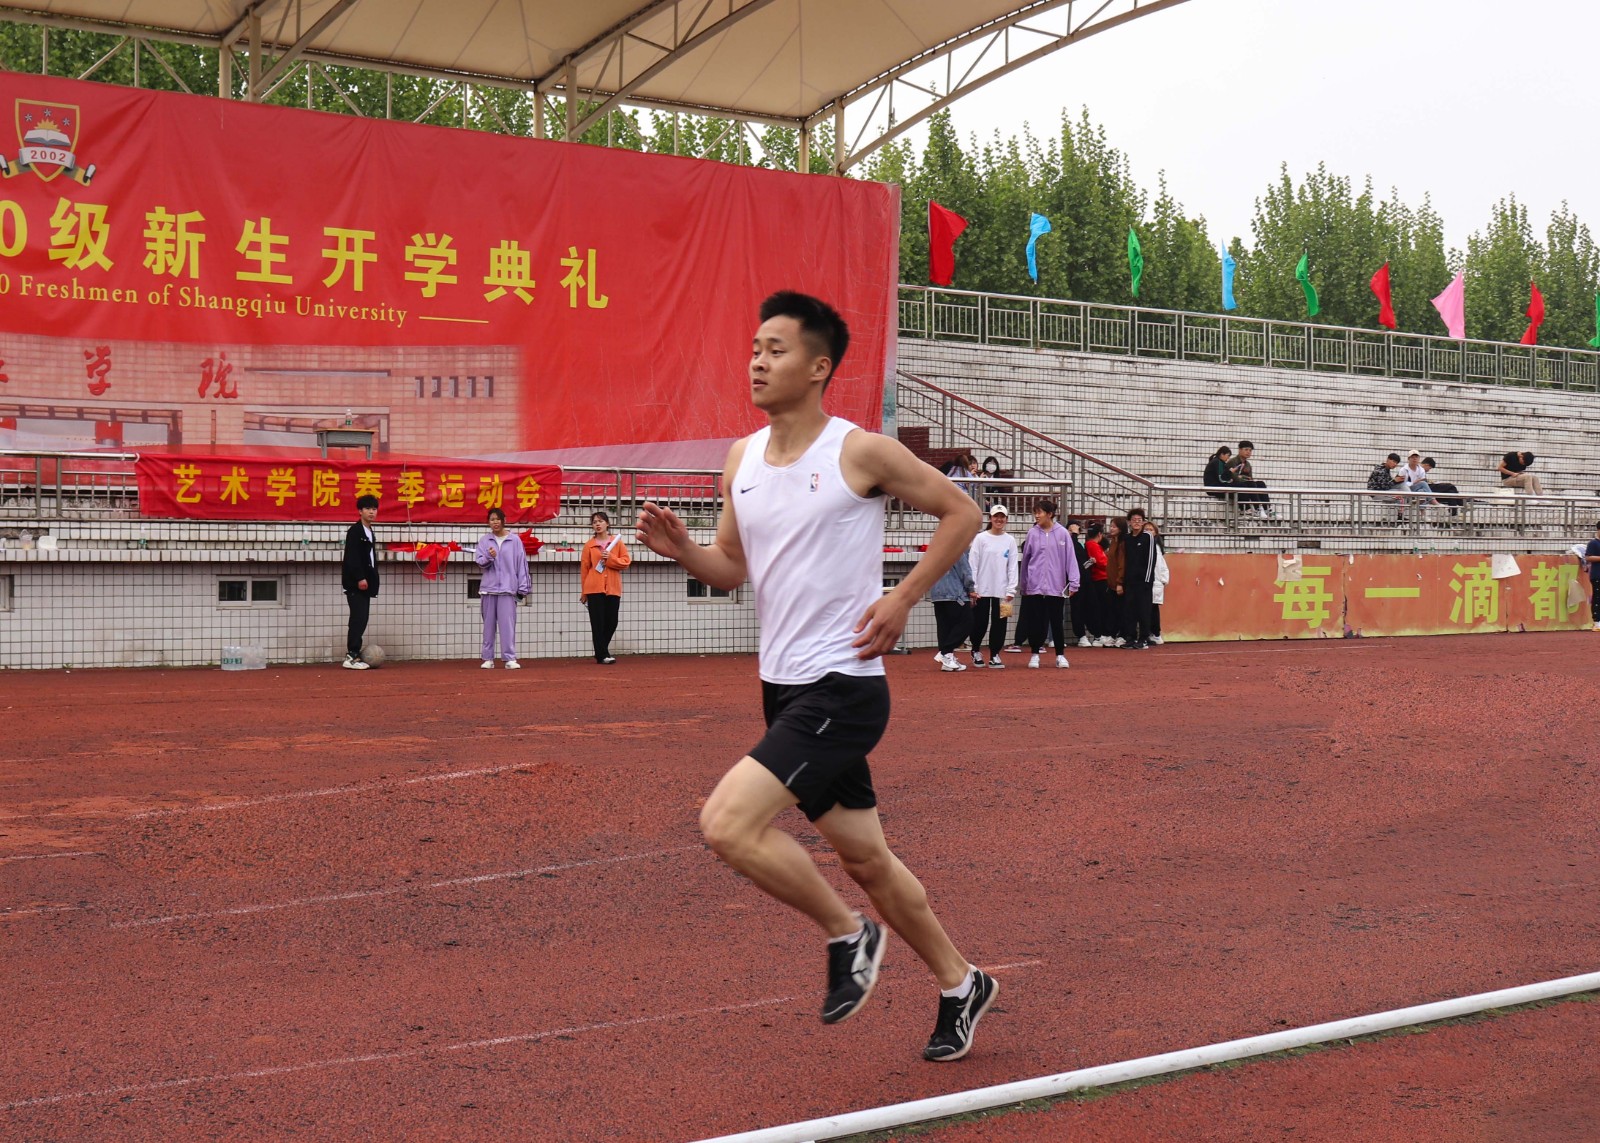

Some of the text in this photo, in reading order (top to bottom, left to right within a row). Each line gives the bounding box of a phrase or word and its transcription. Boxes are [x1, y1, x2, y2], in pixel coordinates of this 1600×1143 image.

[30, 149, 67, 163] 2002
[20, 275, 139, 304] Freshmen
[148, 284, 173, 305] of
[179, 286, 286, 318] Shangqiu
[295, 295, 408, 328] University
[0, 345, 238, 398] 学院
[173, 464, 542, 509] 艺术学院春季运动会
[1273, 562, 1579, 629] 每一滴都
